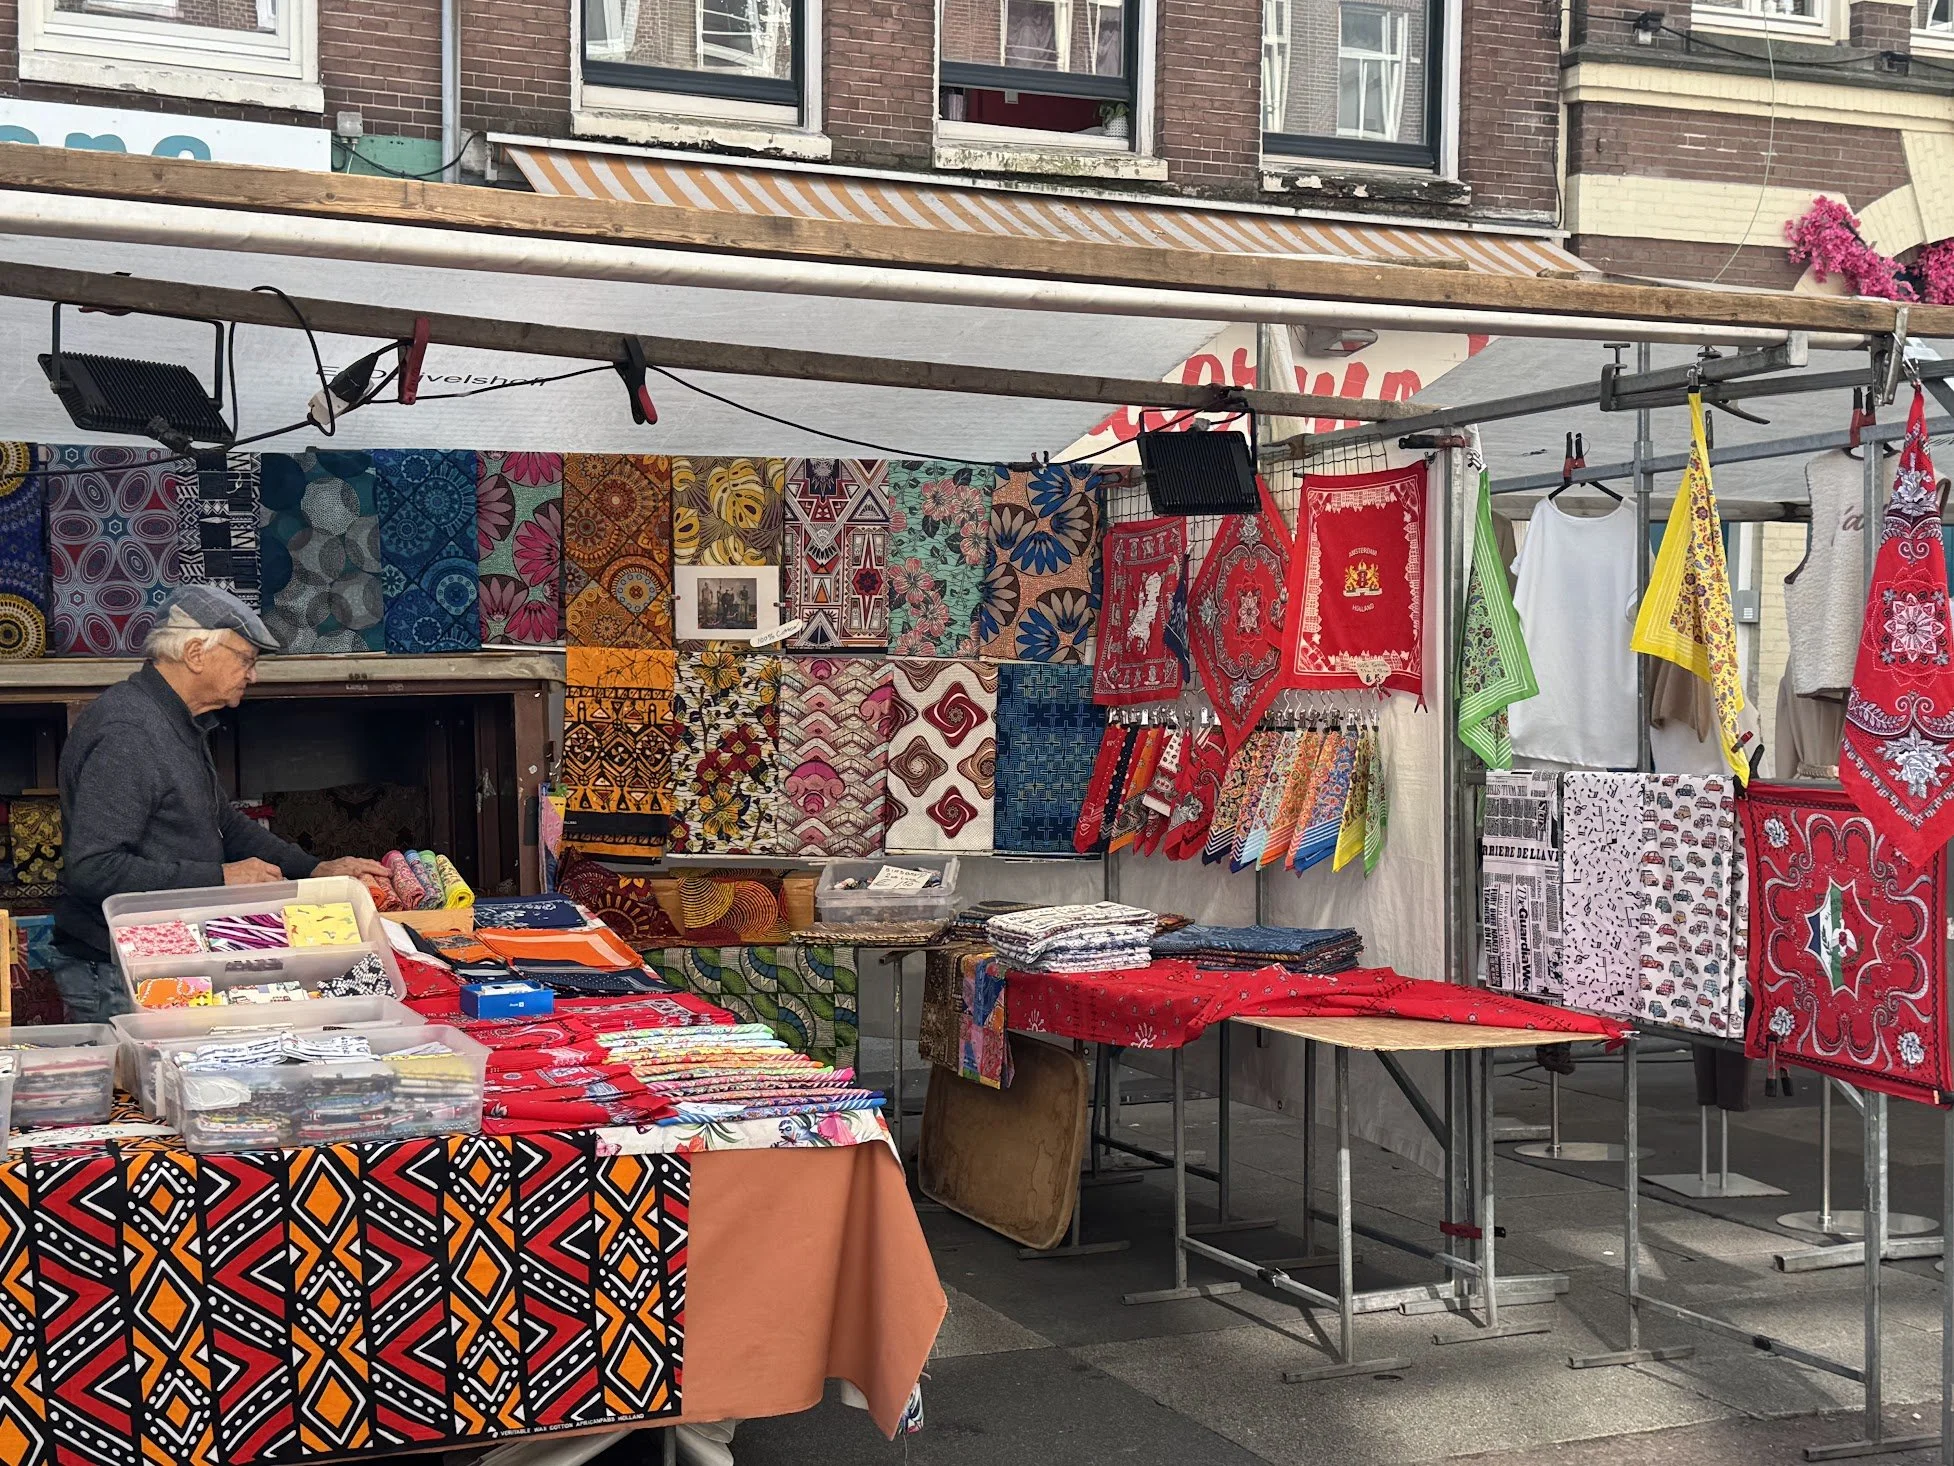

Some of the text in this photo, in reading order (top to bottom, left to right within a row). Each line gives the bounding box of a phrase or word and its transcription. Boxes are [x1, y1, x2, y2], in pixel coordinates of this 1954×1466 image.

[1348, 546, 1378, 557] AMSTERDAM
[1352, 602, 1375, 613] HOLLAND
[500, 1427, 531, 1437] VERITABLE
[549, 1421, 574, 1431] COTTON
[617, 1412, 645, 1422] HOLLAND
